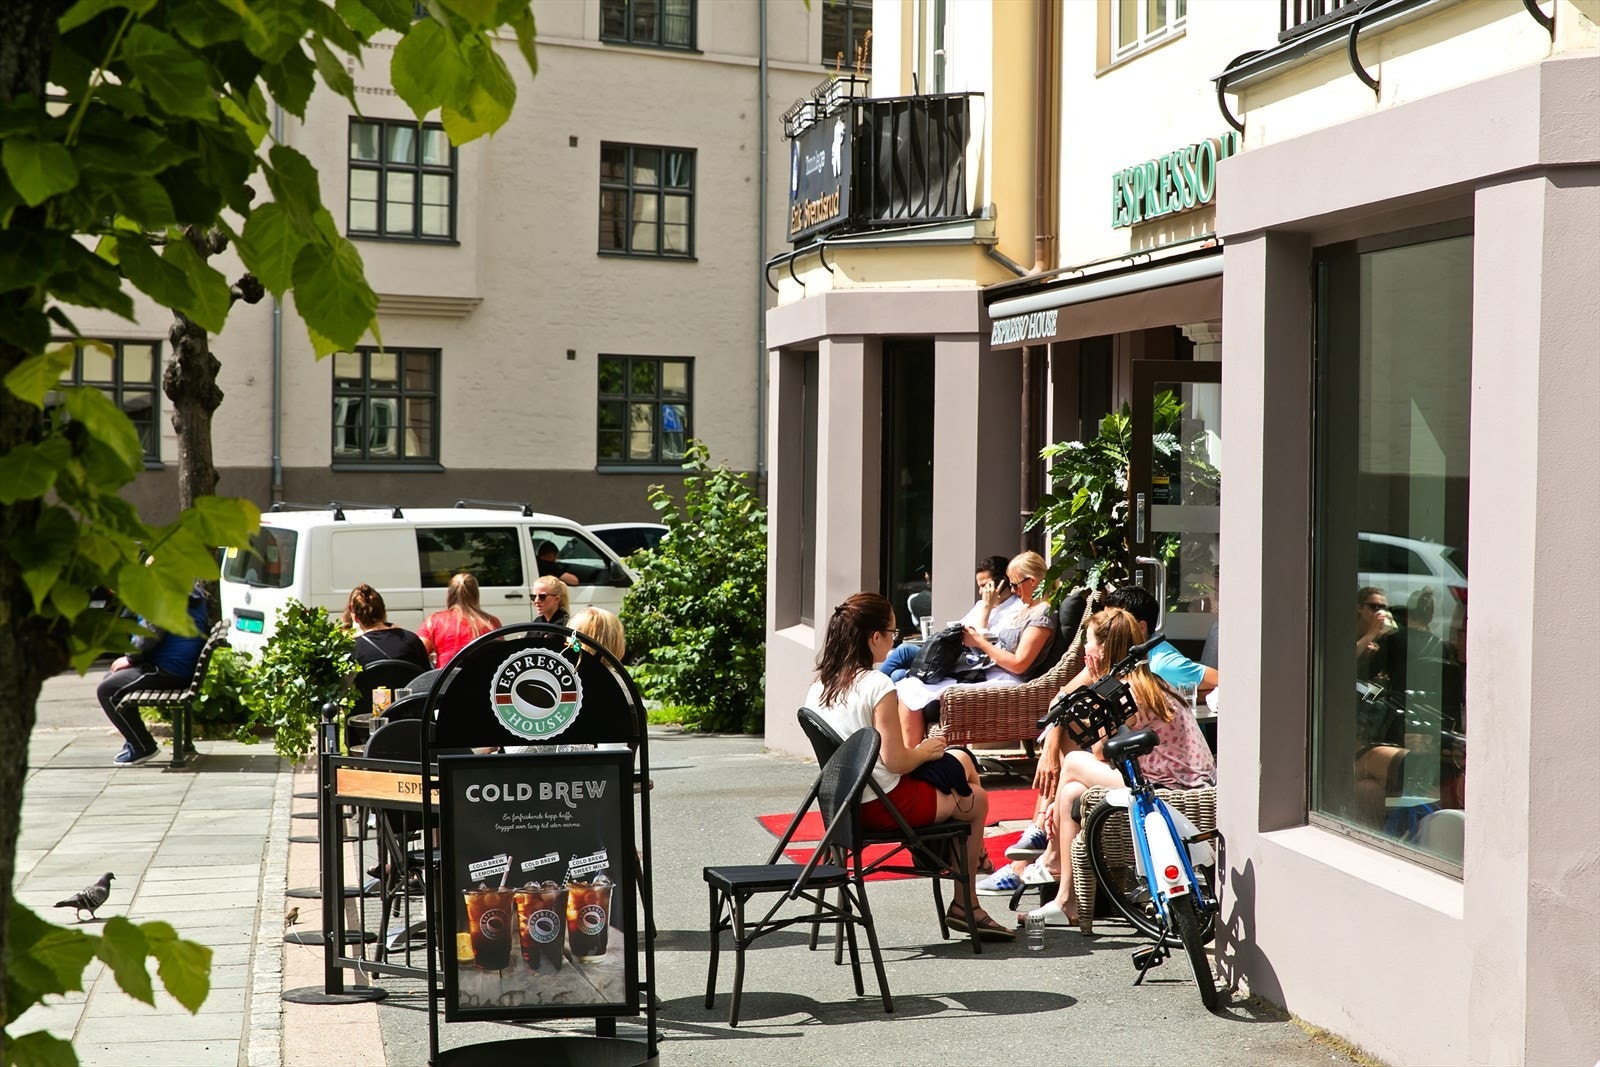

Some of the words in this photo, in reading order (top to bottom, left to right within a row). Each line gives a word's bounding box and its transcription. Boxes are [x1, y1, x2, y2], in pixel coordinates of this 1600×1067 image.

[1112, 138, 1217, 230] ESPRESSO
[991, 315, 1029, 345] ESPRESSO
[1028, 310, 1058, 339] HOUSE
[499, 656, 573, 688] ESPRESSO
[508, 711, 566, 732] HOUSE
[465, 783, 533, 803] COLD
[539, 780, 607, 809] BREW
[472, 861, 488, 870] COLD
[488, 858, 505, 866] BREW
[524, 859, 540, 868] COLD
[540, 856, 557, 865] BREW
[572, 857, 588, 866] COLD
[588, 854, 604, 863] BREW
[573, 867, 595, 875] SWEET
[594, 862, 607, 870] MILK
[474, 866, 506, 878] LEMONADE
